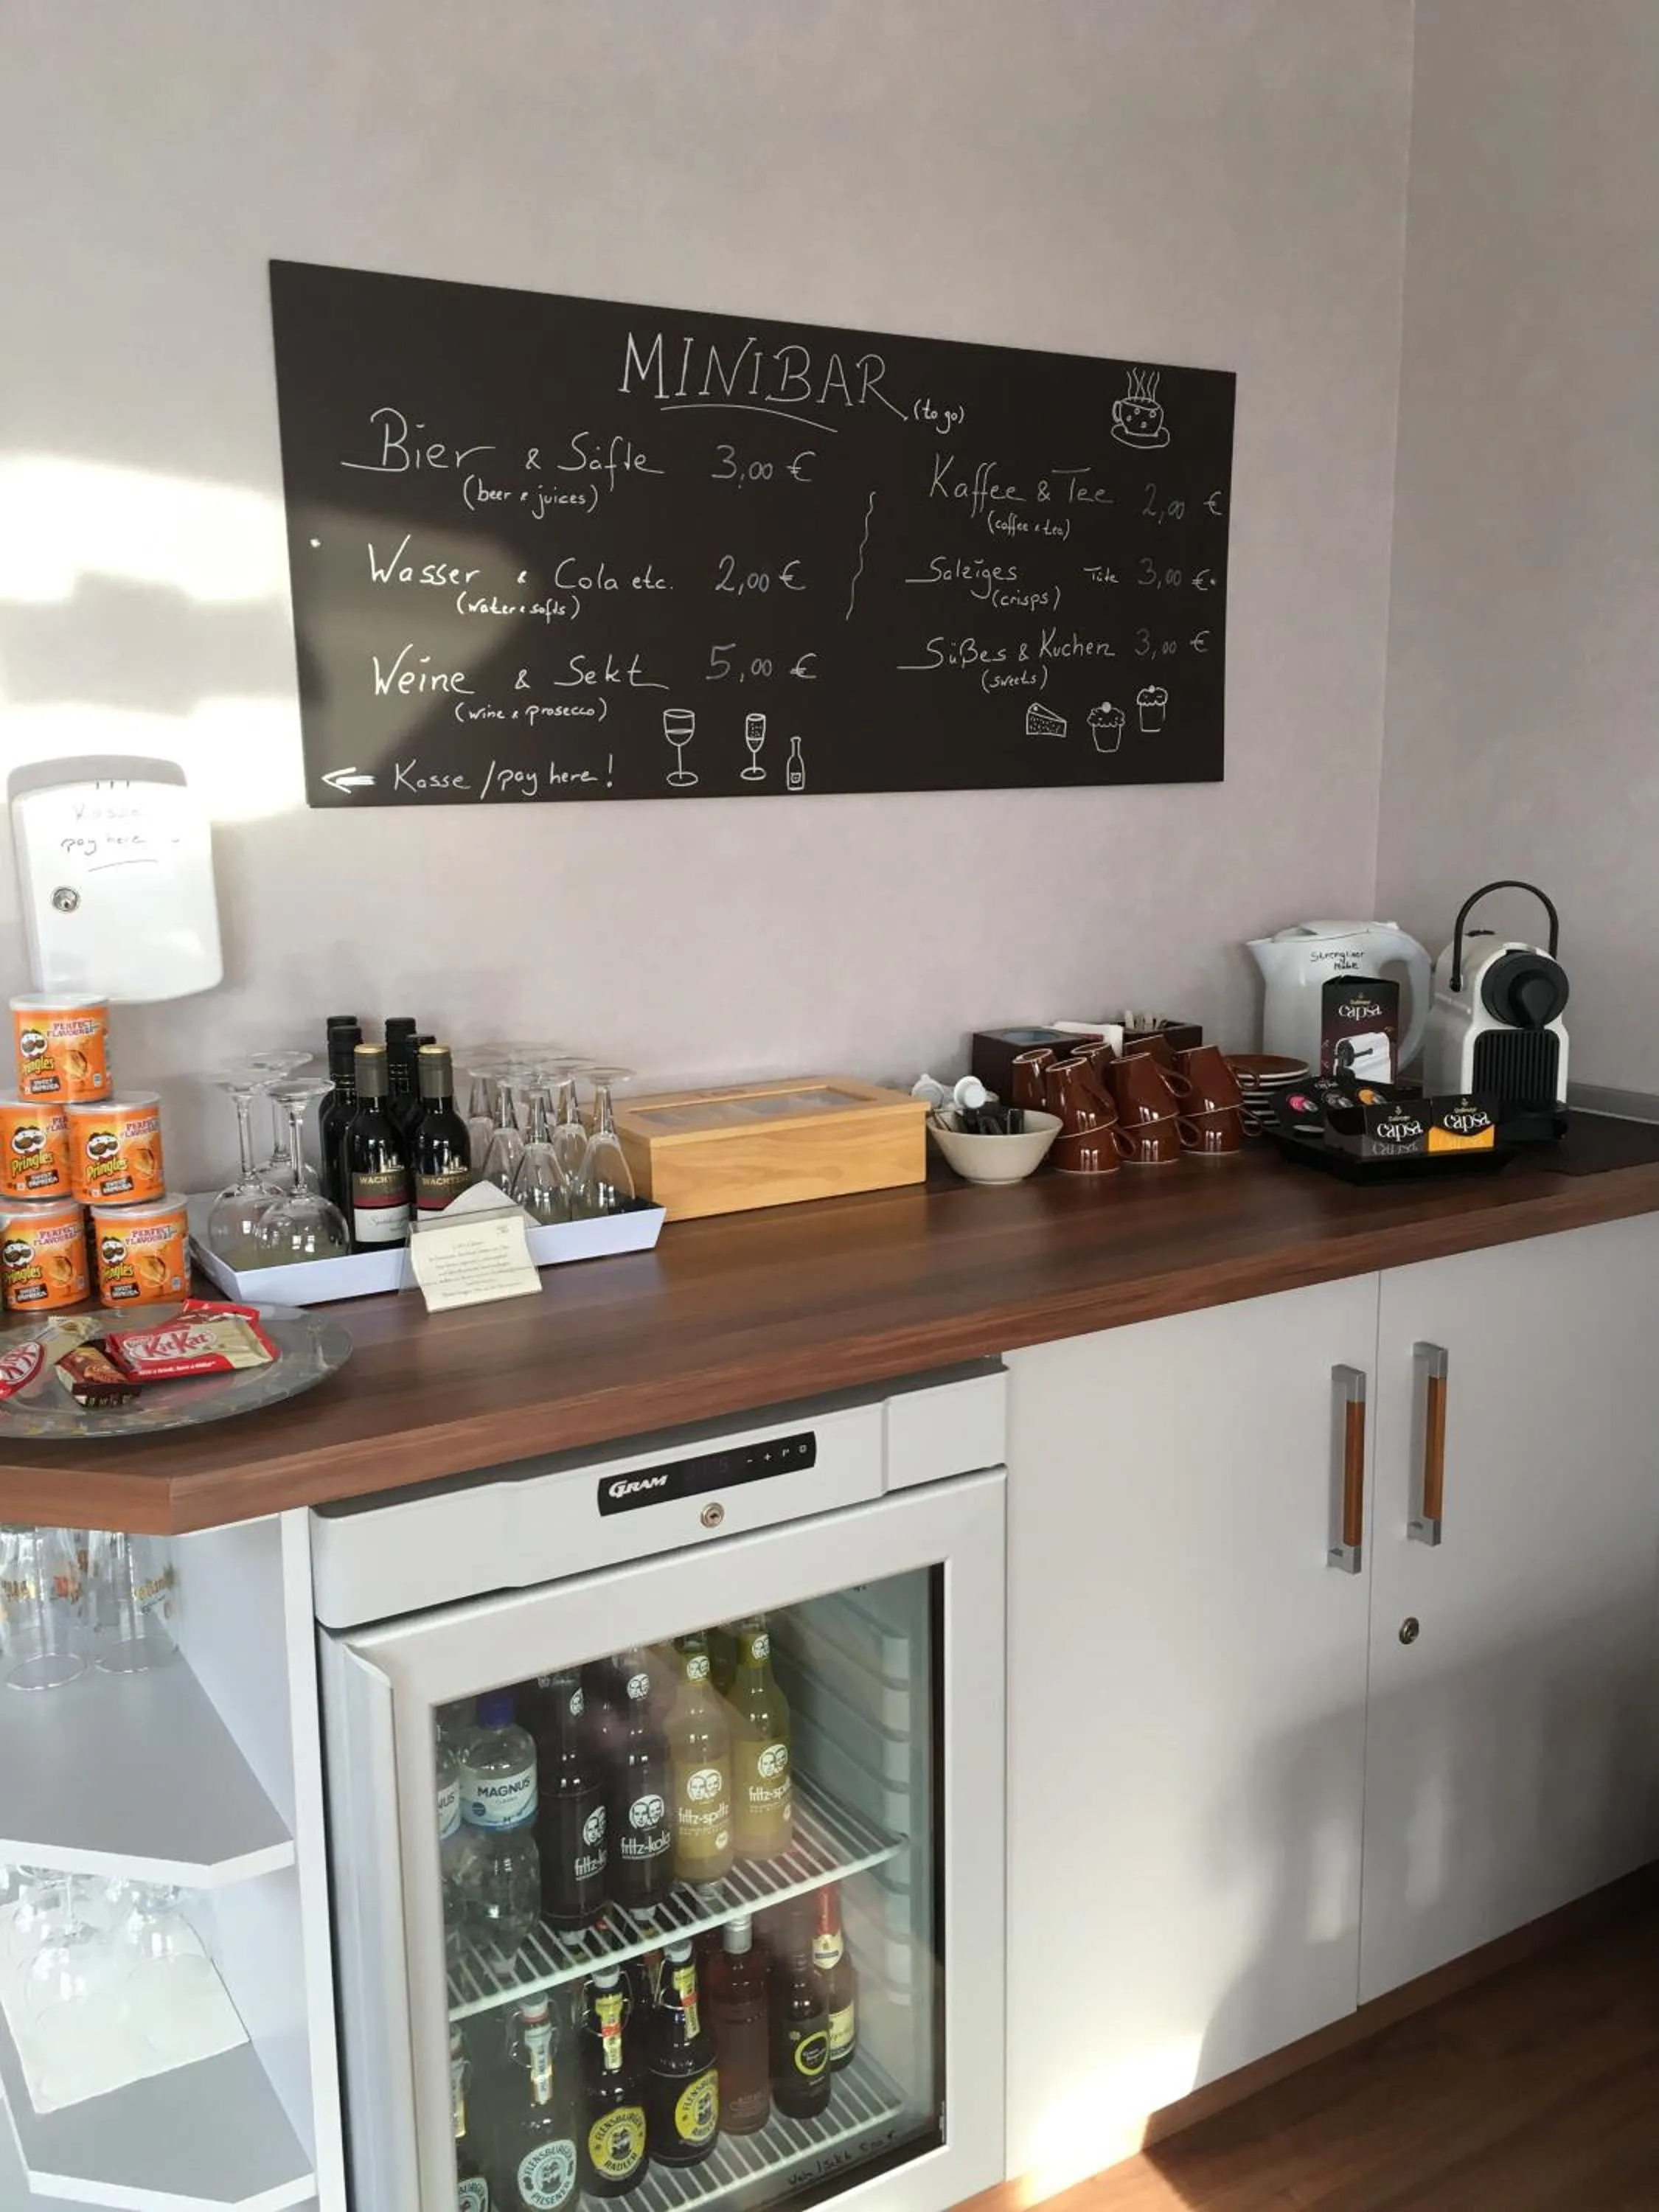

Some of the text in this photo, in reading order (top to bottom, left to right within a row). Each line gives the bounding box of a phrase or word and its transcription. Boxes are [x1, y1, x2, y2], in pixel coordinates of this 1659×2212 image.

[618, 332, 908, 420] MINIBAR
[914, 398, 964, 434] (to go)
[341, 408, 816, 492] Bier & Säfte 3,00 €
[463, 474, 512, 511] (beer
[532, 484, 598, 519] juices)
[930, 453, 1222, 524] Kaffee & Tee 2,00 €
[987, 511, 1029, 537] (coffee
[1041, 518, 1070, 540] tea)
[368, 534, 481, 585] Wasser
[554, 557, 617, 590] Cola
[632, 565, 673, 590] etc.
[715, 554, 769, 595] 2,00
[779, 560, 806, 591] €
[905, 556, 1018, 600] Salziges
[1137, 557, 1181, 590] 3,00
[456, 591, 515, 615] (water
[992, 585, 1060, 611] (crisps)
[897, 627, 1210, 669] Süßes & Kuchen 3,00 €
[372, 643, 817, 695] Weine & Sekt 5,00 €
[981, 666, 1048, 693] (sweets)
[455, 701, 507, 722] (wine
[525, 698, 608, 726] prosecco)
[394, 759, 470, 792] Kasse
[60, 838, 97, 856] pay
[11, 1152, 53, 1178] Pringles
[86, 1157, 128, 1182] Pringles
[608, 1475, 669, 1498] GRAM
[477, 1776, 531, 1798] MAGNUS
